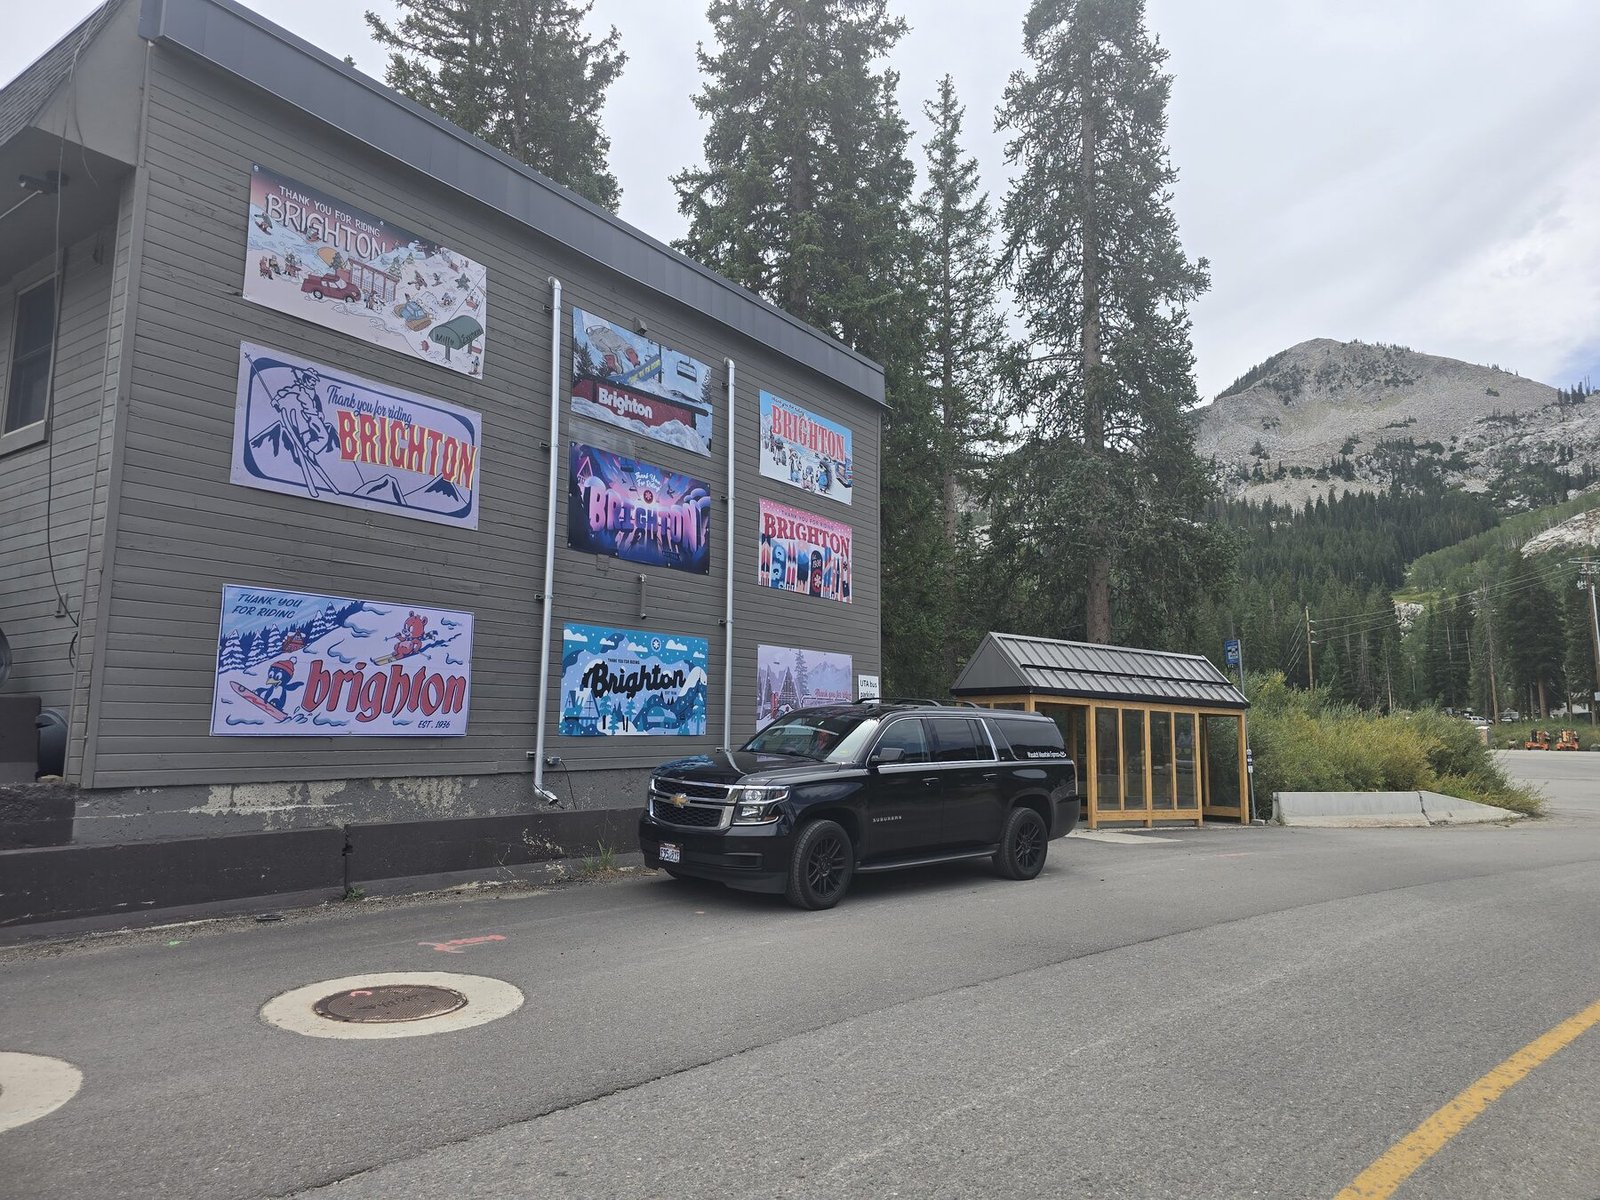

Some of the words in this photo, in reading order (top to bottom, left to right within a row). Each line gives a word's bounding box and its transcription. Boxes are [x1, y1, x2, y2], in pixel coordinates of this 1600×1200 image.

[266, 193, 386, 261] BRIGHTON
[279, 185, 310, 206] THANK
[314, 200, 332, 216] YOU
[335, 209, 352, 225] FOR
[355, 219, 381, 237] RIDING
[327, 385, 356, 408] Thank
[354, 399, 373, 417] you
[372, 400, 387, 420] for
[388, 405, 412, 430] riding
[598, 387, 653, 419] Brighton
[337, 409, 478, 490] BRIGHTON
[771, 404, 845, 462] BRIGHTON
[586, 477, 699, 553] BRIGHTON
[763, 512, 850, 560] BRIGHTON
[232, 605, 257, 616] FOR
[256, 607, 296, 619] RIDING
[238, 593, 277, 605] THANK
[278, 598, 303, 608] YOU
[301, 659, 467, 722] brighton
[581, 660, 687, 699] Brighton
[859, 680, 869, 688] UTA
[860, 691, 876, 699] parking
[434, 720, 451, 729] 1936
[872, 815, 902, 823] SUBURBAN
